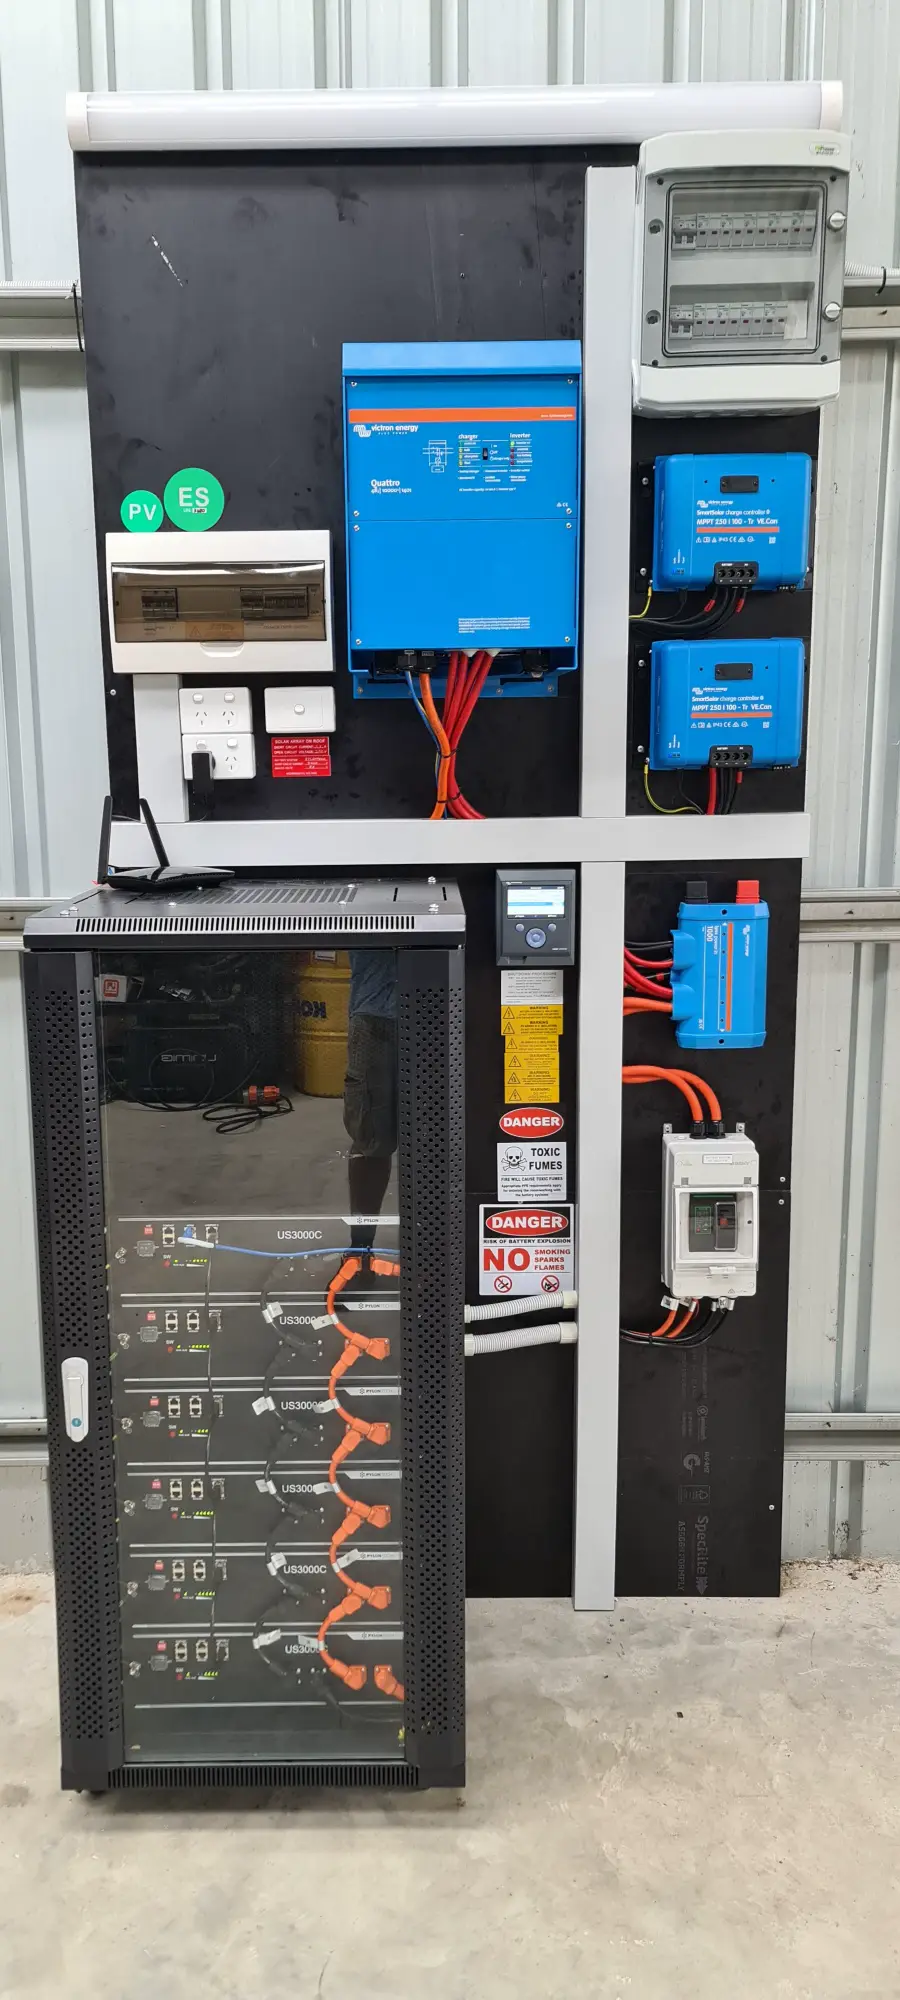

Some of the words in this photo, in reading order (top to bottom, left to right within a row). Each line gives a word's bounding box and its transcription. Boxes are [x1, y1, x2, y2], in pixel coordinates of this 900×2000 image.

[370, 479, 400, 487] Quattro
[179, 487, 209, 507] ES
[129, 504, 157, 520] PV
[503, 1116, 560, 1127] DANGER
[531, 1148, 560, 1156] TOXIC
[529, 1161, 562, 1170] FUMES
[491, 1216, 563, 1228] DANGER
[277, 1230, 322, 1240] US3000C
[483, 1248, 530, 1271] NO
[695, 1516, 709, 1574] SpecRite
[283, 1565, 327, 1574] US3000C
